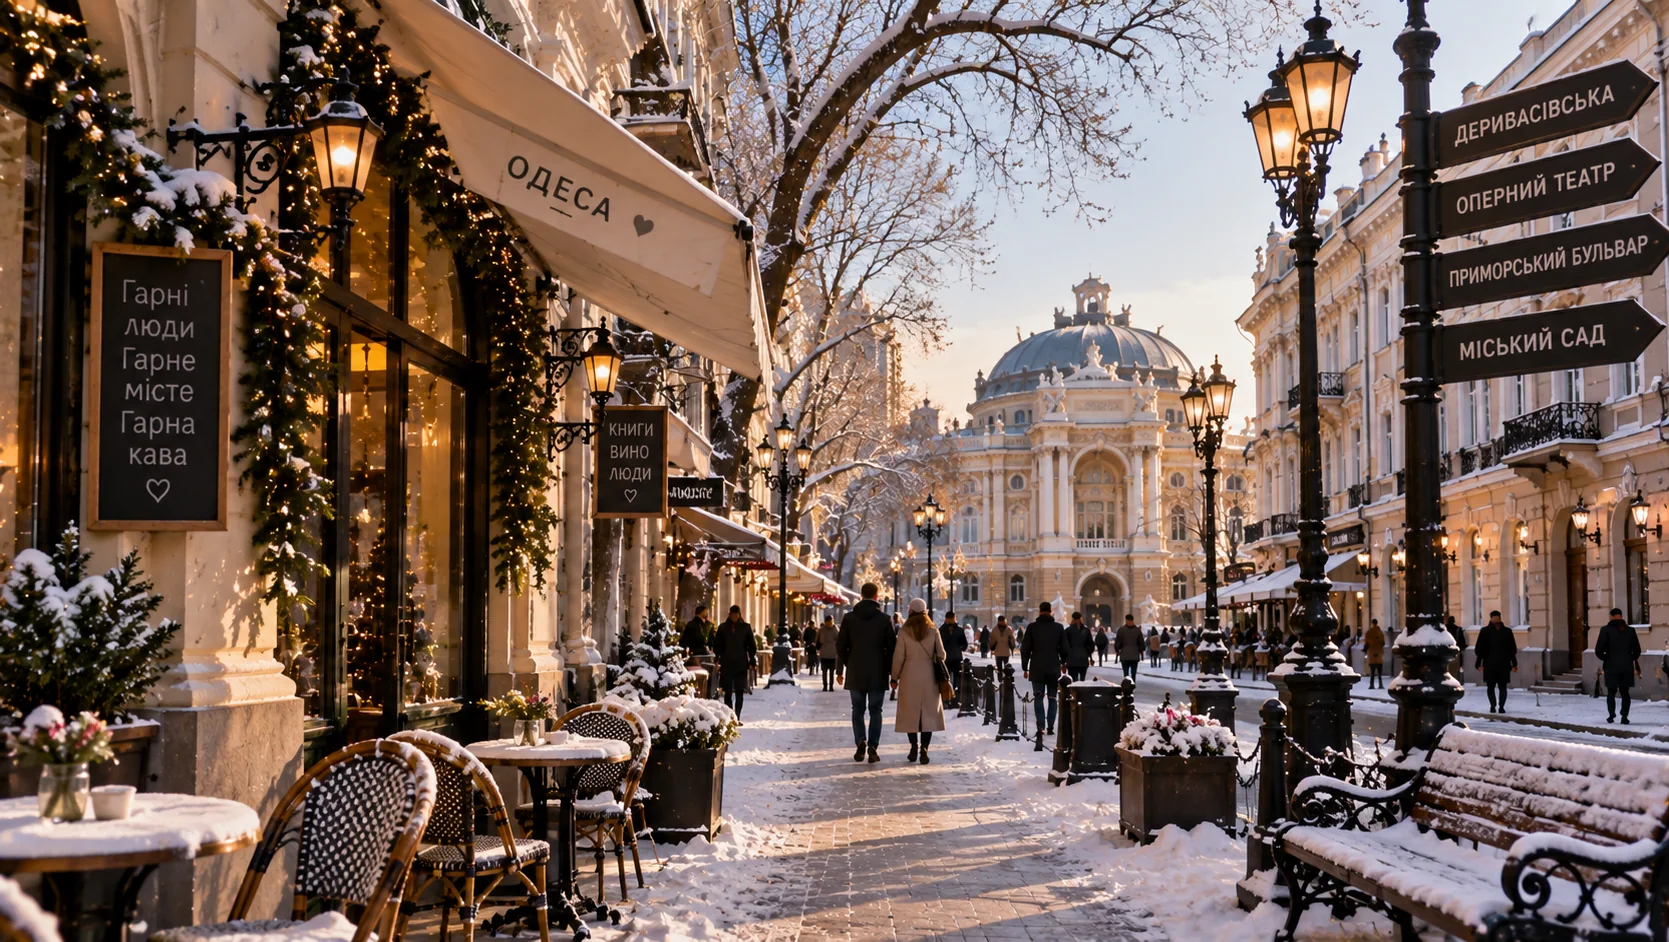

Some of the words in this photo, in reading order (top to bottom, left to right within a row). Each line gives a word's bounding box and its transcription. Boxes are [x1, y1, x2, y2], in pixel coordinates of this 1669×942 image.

[1454, 84, 1615, 147] ДЕРИВАСІВСЬКА
[507, 155, 611, 222] ОДЕСА
[1456, 174, 1547, 214] ОПЕРНИЙ
[1553, 161, 1616, 192] ТЕАТР
[1449, 247, 1567, 288] ПРИМОРСЬКИЙ
[1572, 235, 1649, 266] БУЛЬВАР
[122, 279, 188, 310] Гарні
[124, 318, 194, 341] люди
[1459, 327, 1553, 361] МІСЬКИЙ
[1561, 324, 1606, 347] САД
[122, 347, 196, 376] Гарне
[125, 378, 194, 402] місте
[121, 410, 195, 440] Гарна
[609, 422, 654, 437] КНИГИ
[129, 447, 187, 466] кава
[610, 445, 650, 459] ВИНО
[609, 467, 652, 482] ЛЮДИ
